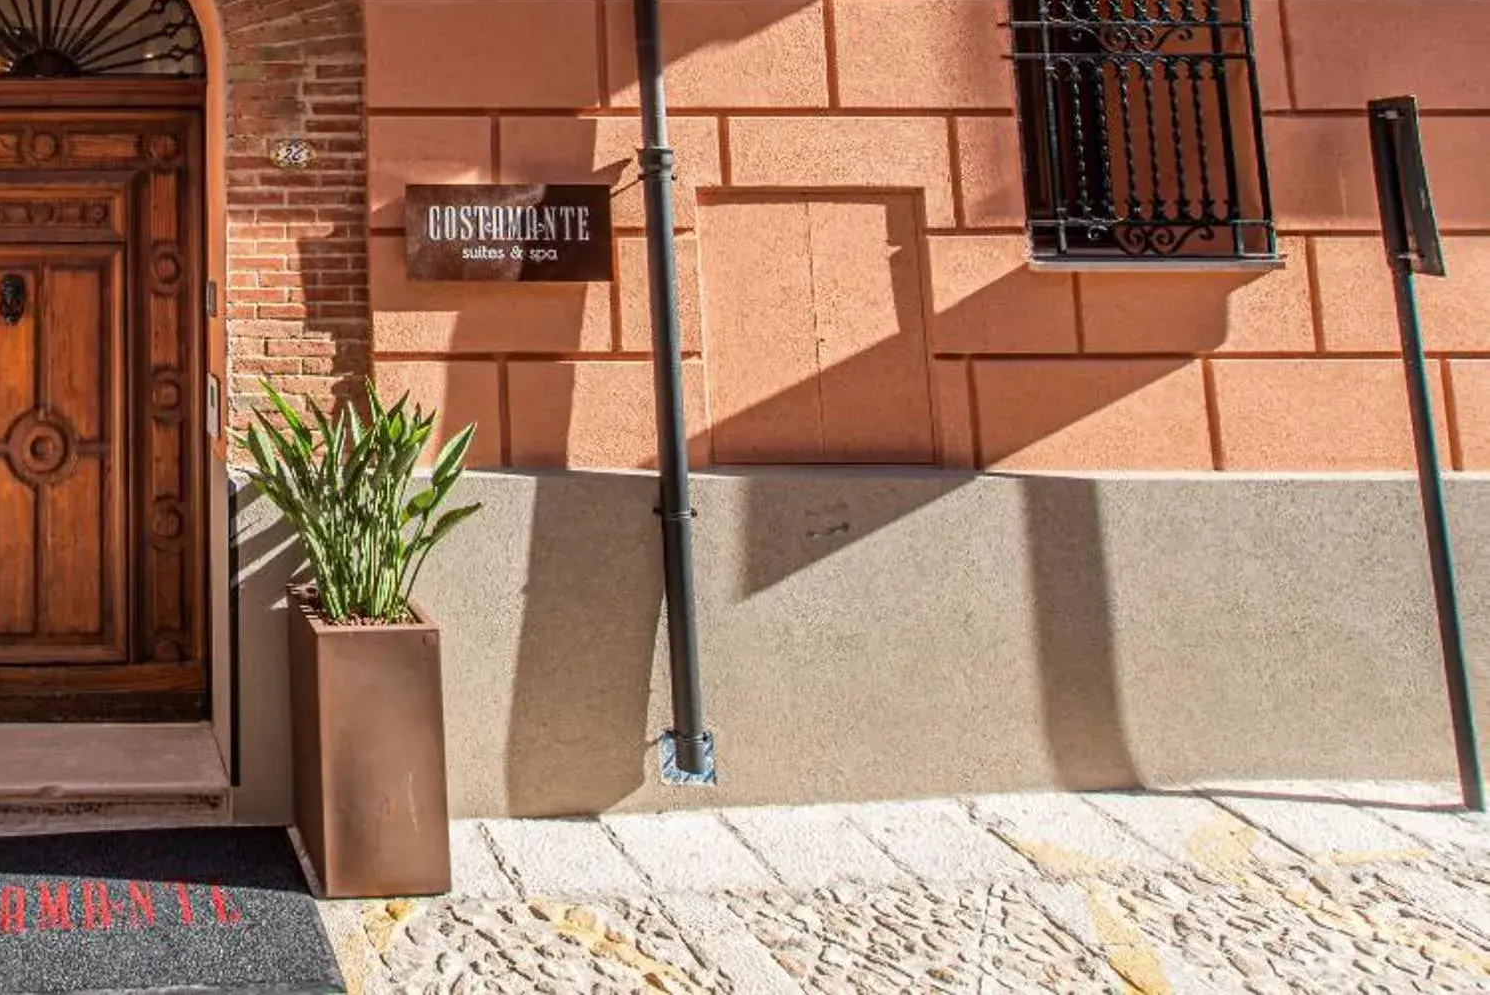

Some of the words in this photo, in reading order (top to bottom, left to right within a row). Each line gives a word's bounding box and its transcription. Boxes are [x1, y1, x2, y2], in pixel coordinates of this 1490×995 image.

[428, 205, 590, 242] COSTAMANTE
[462, 245, 505, 260] suites
[509, 245, 524, 260] &
[529, 249, 558, 263] spa
